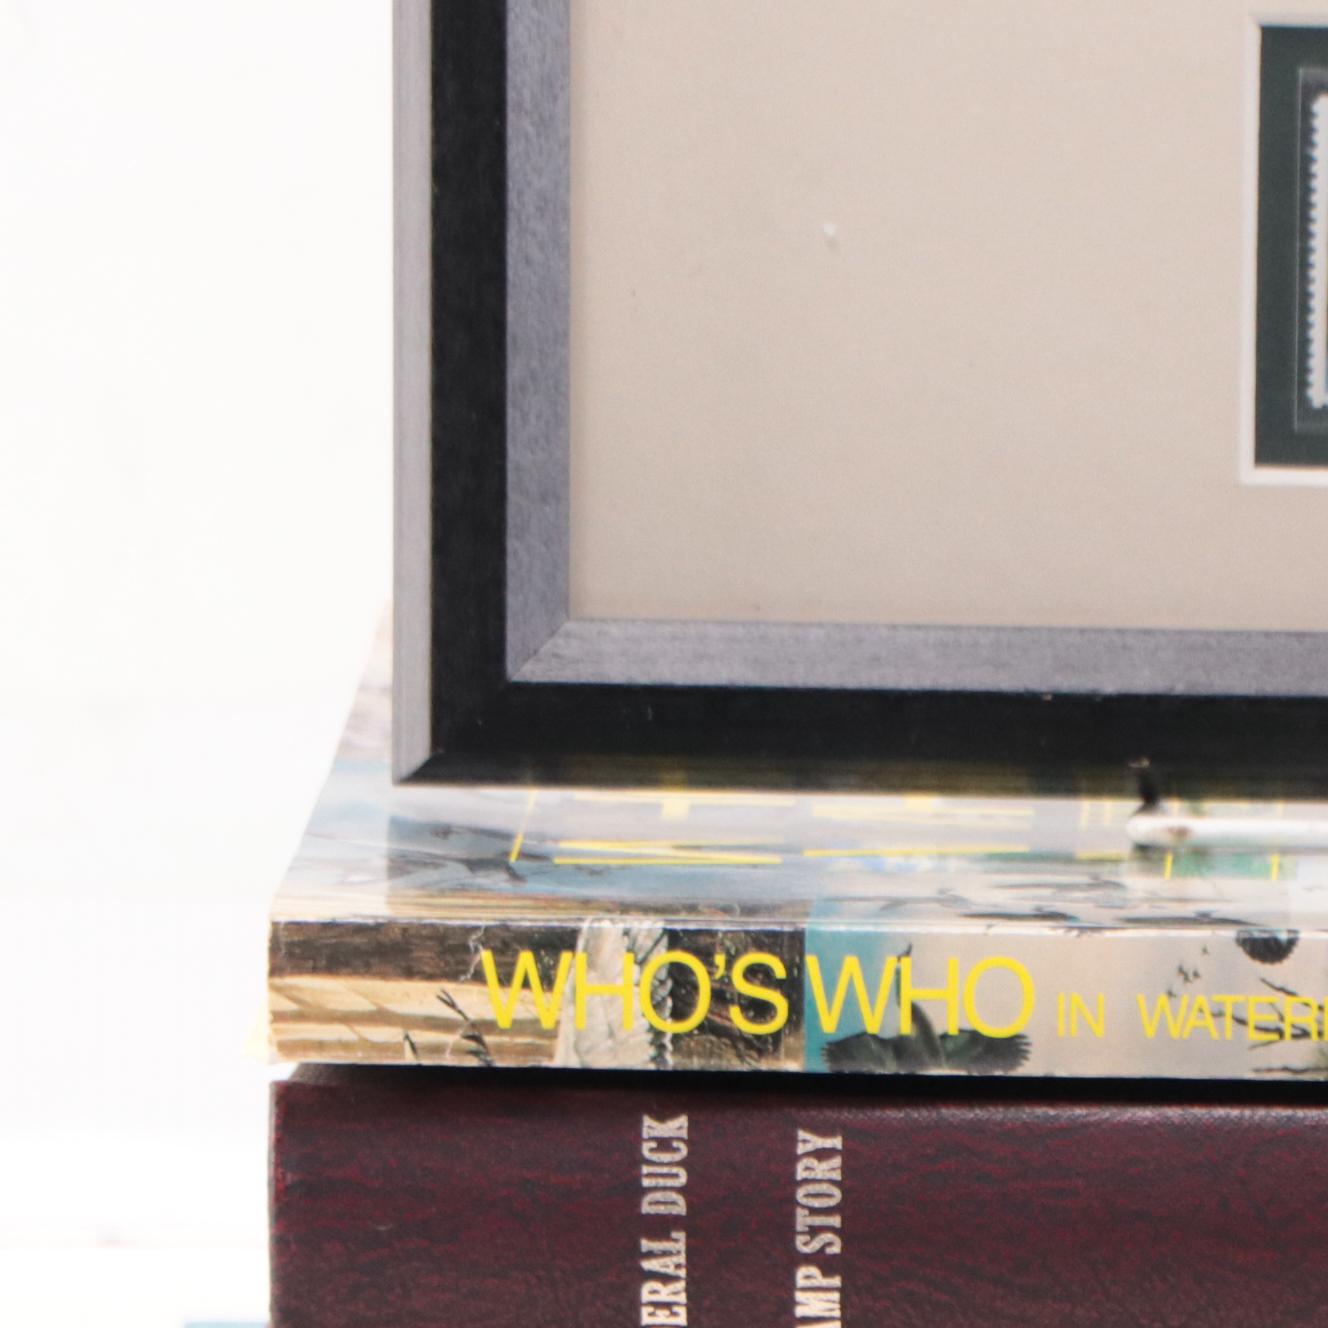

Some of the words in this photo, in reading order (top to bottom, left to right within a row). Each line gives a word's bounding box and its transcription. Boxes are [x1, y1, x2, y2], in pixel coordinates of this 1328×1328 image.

[481, 949, 790, 1035] WHO'S
[806, 954, 1036, 1038] WHO
[1057, 992, 1105, 1038] IN
[641, 1113, 689, 1216] DUCK
[795, 1129, 843, 1255] STORY
